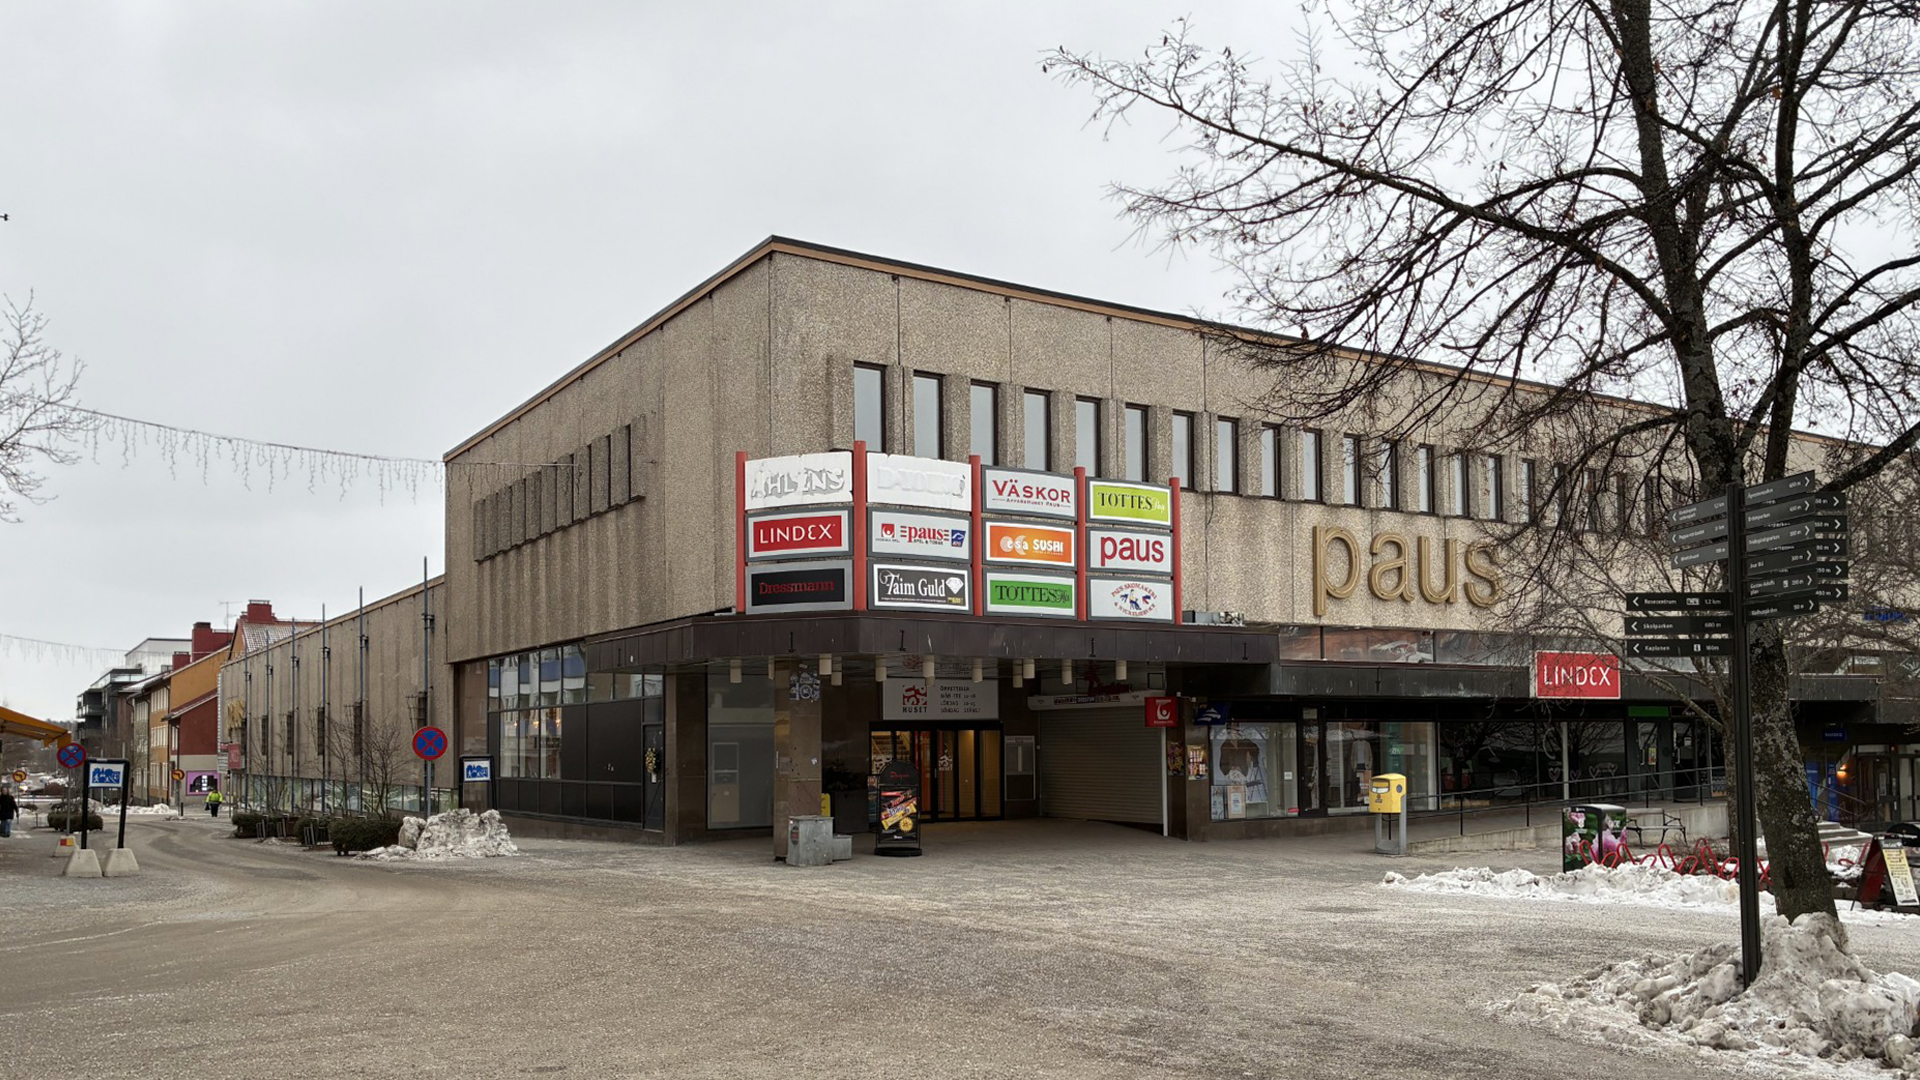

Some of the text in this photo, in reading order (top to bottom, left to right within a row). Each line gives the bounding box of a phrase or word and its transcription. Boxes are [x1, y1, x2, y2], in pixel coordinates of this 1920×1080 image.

[992, 478, 1071, 504] VÄSKOR
[1097, 491, 1153, 511] TOTTES
[759, 523, 836, 545] LINDEX
[907, 525, 945, 544] paus
[1032, 538, 1064, 553] SUSHI
[1100, 536, 1165, 568] paus
[1312, 525, 1502, 617] paus
[759, 581, 834, 595] Dressmann
[918, 578, 946, 597] Guld
[994, 585, 1058, 604] TOTTES
[1543, 665, 1611, 687] LINDEX
